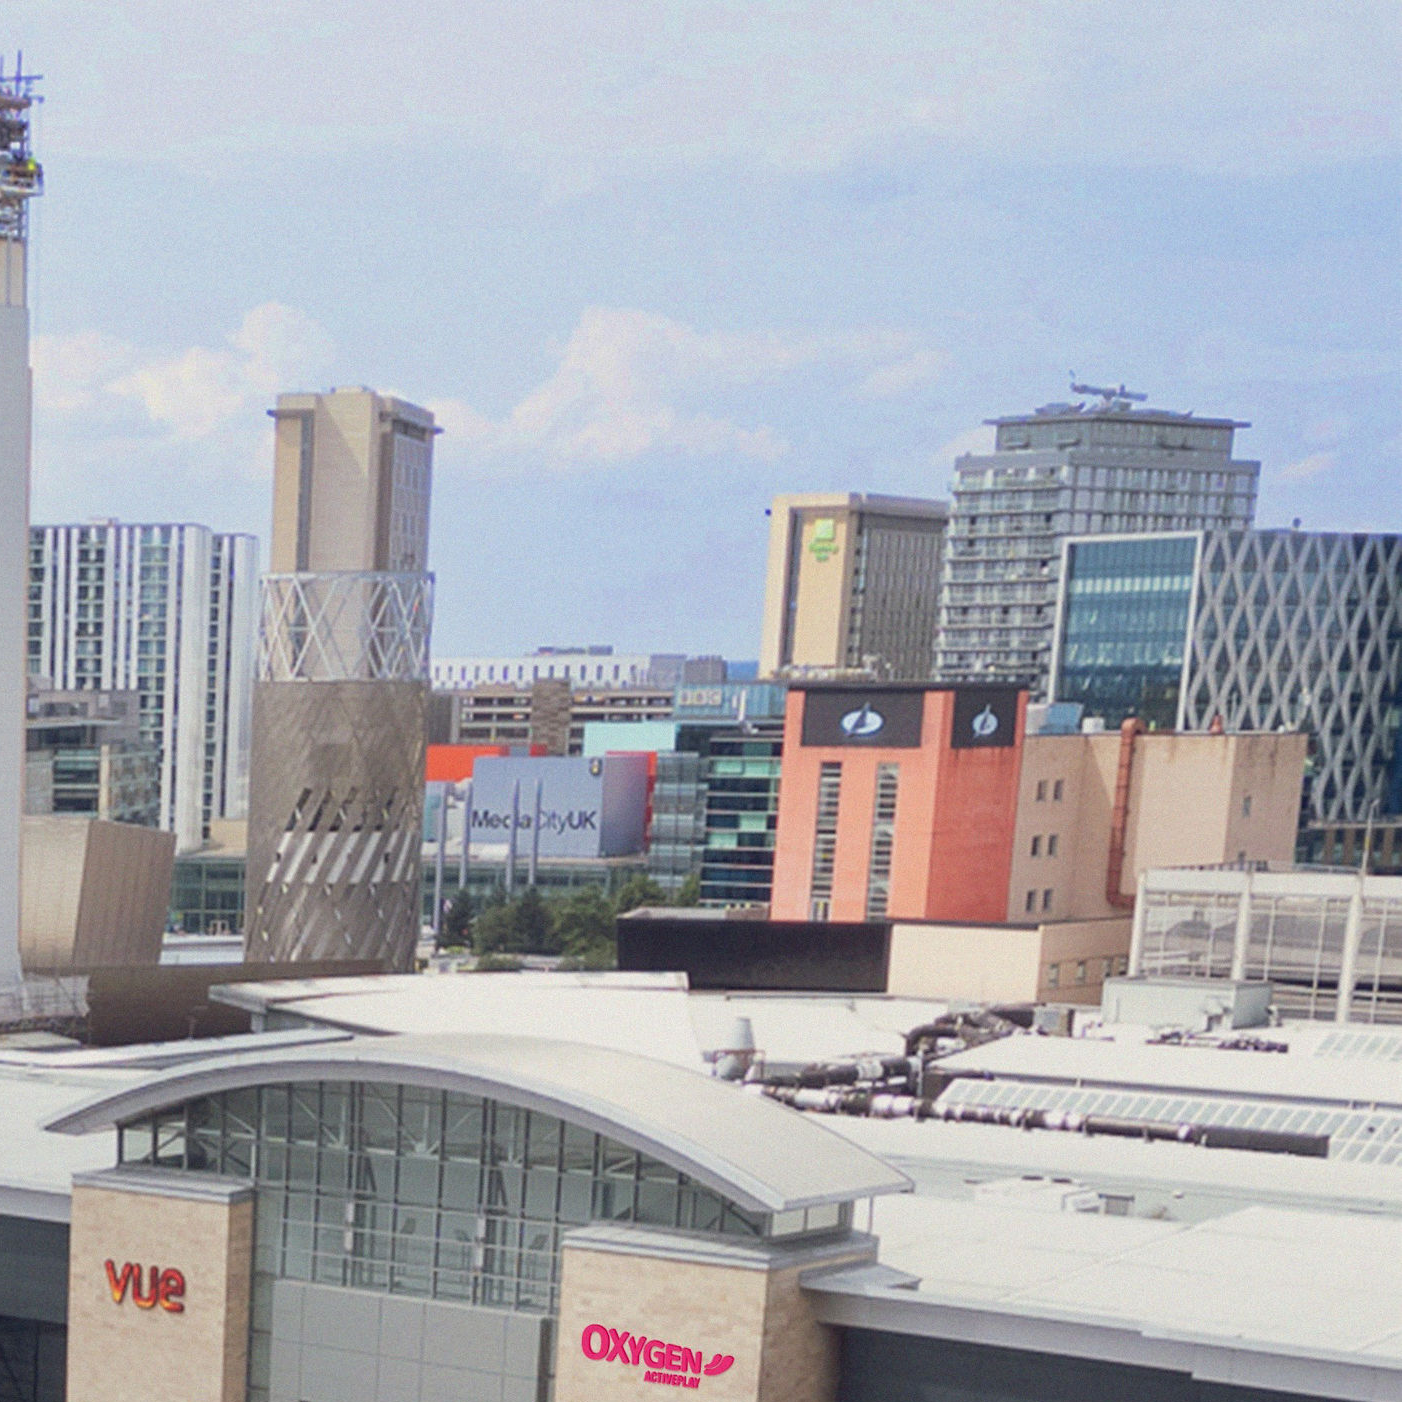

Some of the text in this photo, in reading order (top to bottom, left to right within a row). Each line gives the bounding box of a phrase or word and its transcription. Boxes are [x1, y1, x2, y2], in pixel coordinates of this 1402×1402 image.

[471, 809, 597, 836] MedaCityUK
[581, 1323, 703, 1375] OXYGEN
[644, 1370, 701, 1389] ACTIVEPLAY
